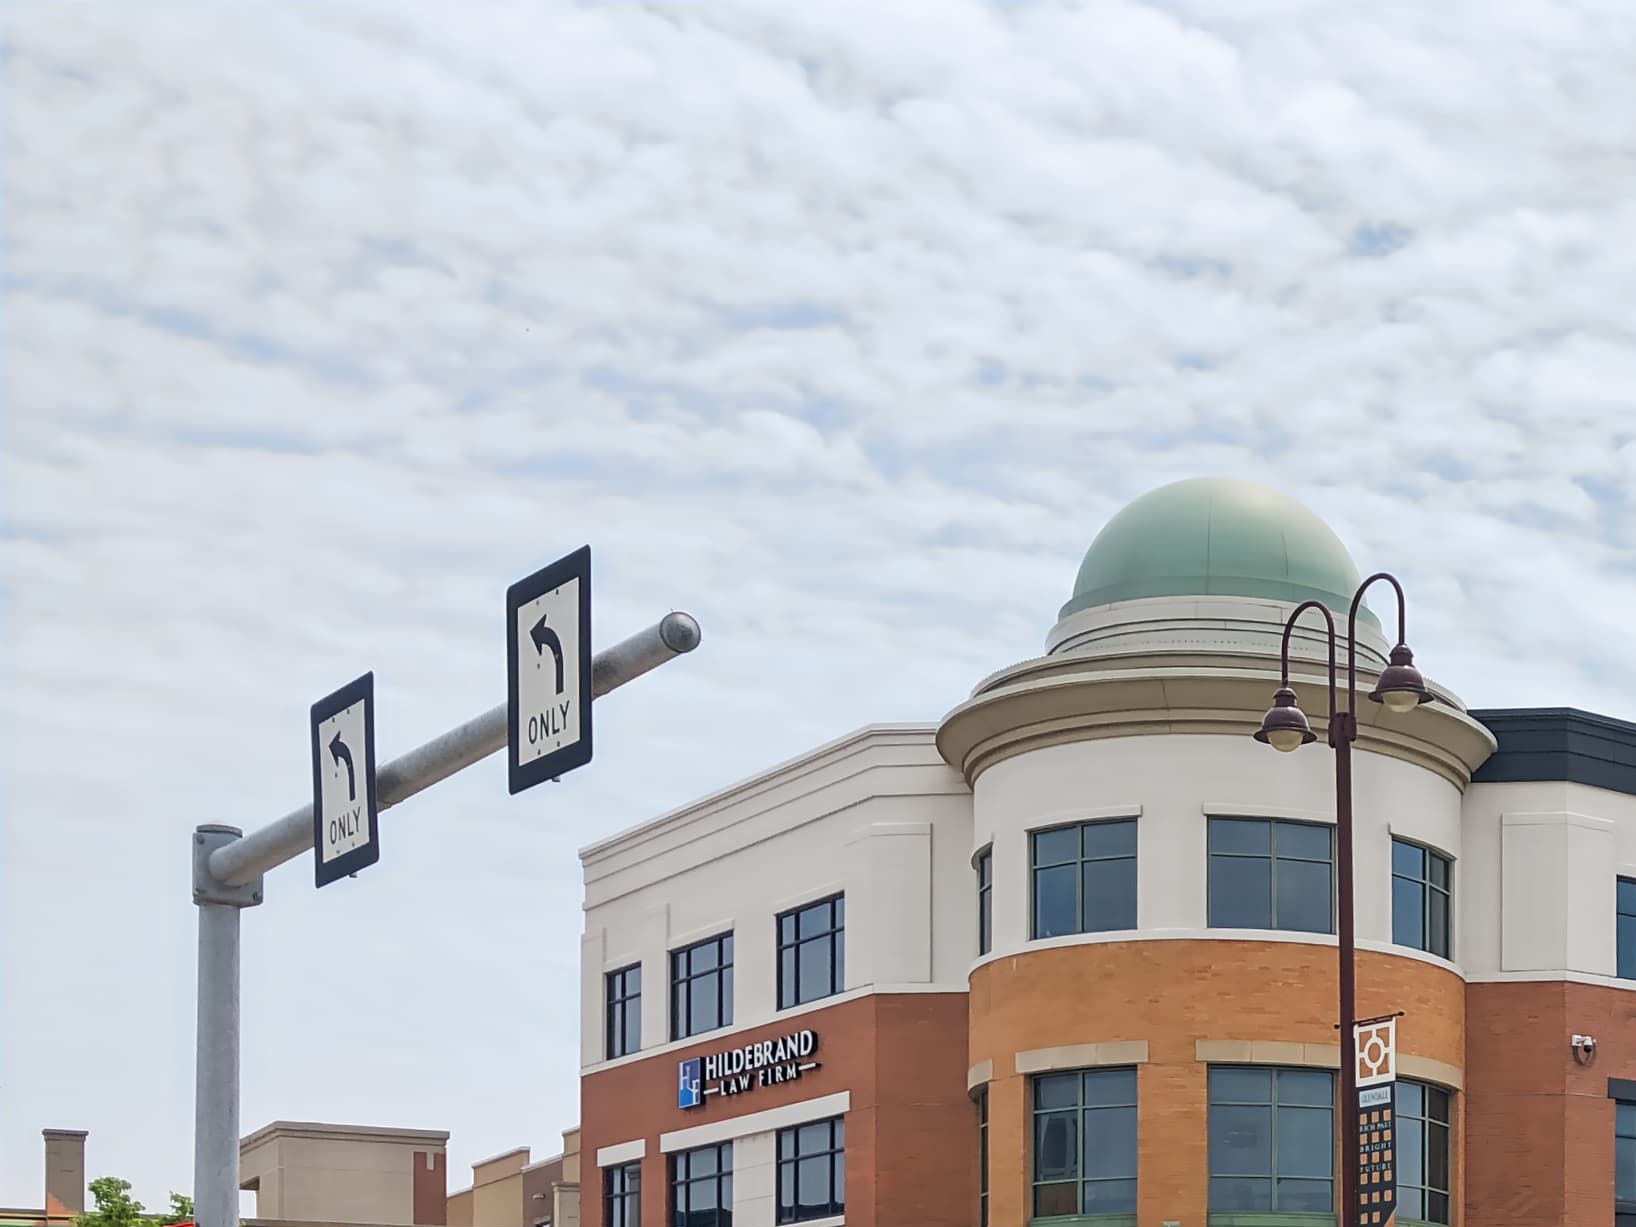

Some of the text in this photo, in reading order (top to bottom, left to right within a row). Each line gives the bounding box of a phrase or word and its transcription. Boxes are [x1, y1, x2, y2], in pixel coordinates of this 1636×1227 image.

[528, 699, 570, 745] ONLY
[329, 806, 361, 845] ONLY
[705, 1029, 814, 1081] HILDEBRAND
[720, 1062, 797, 1096] LAW FIRM
[1359, 1141, 1393, 1153] BRIGHT
